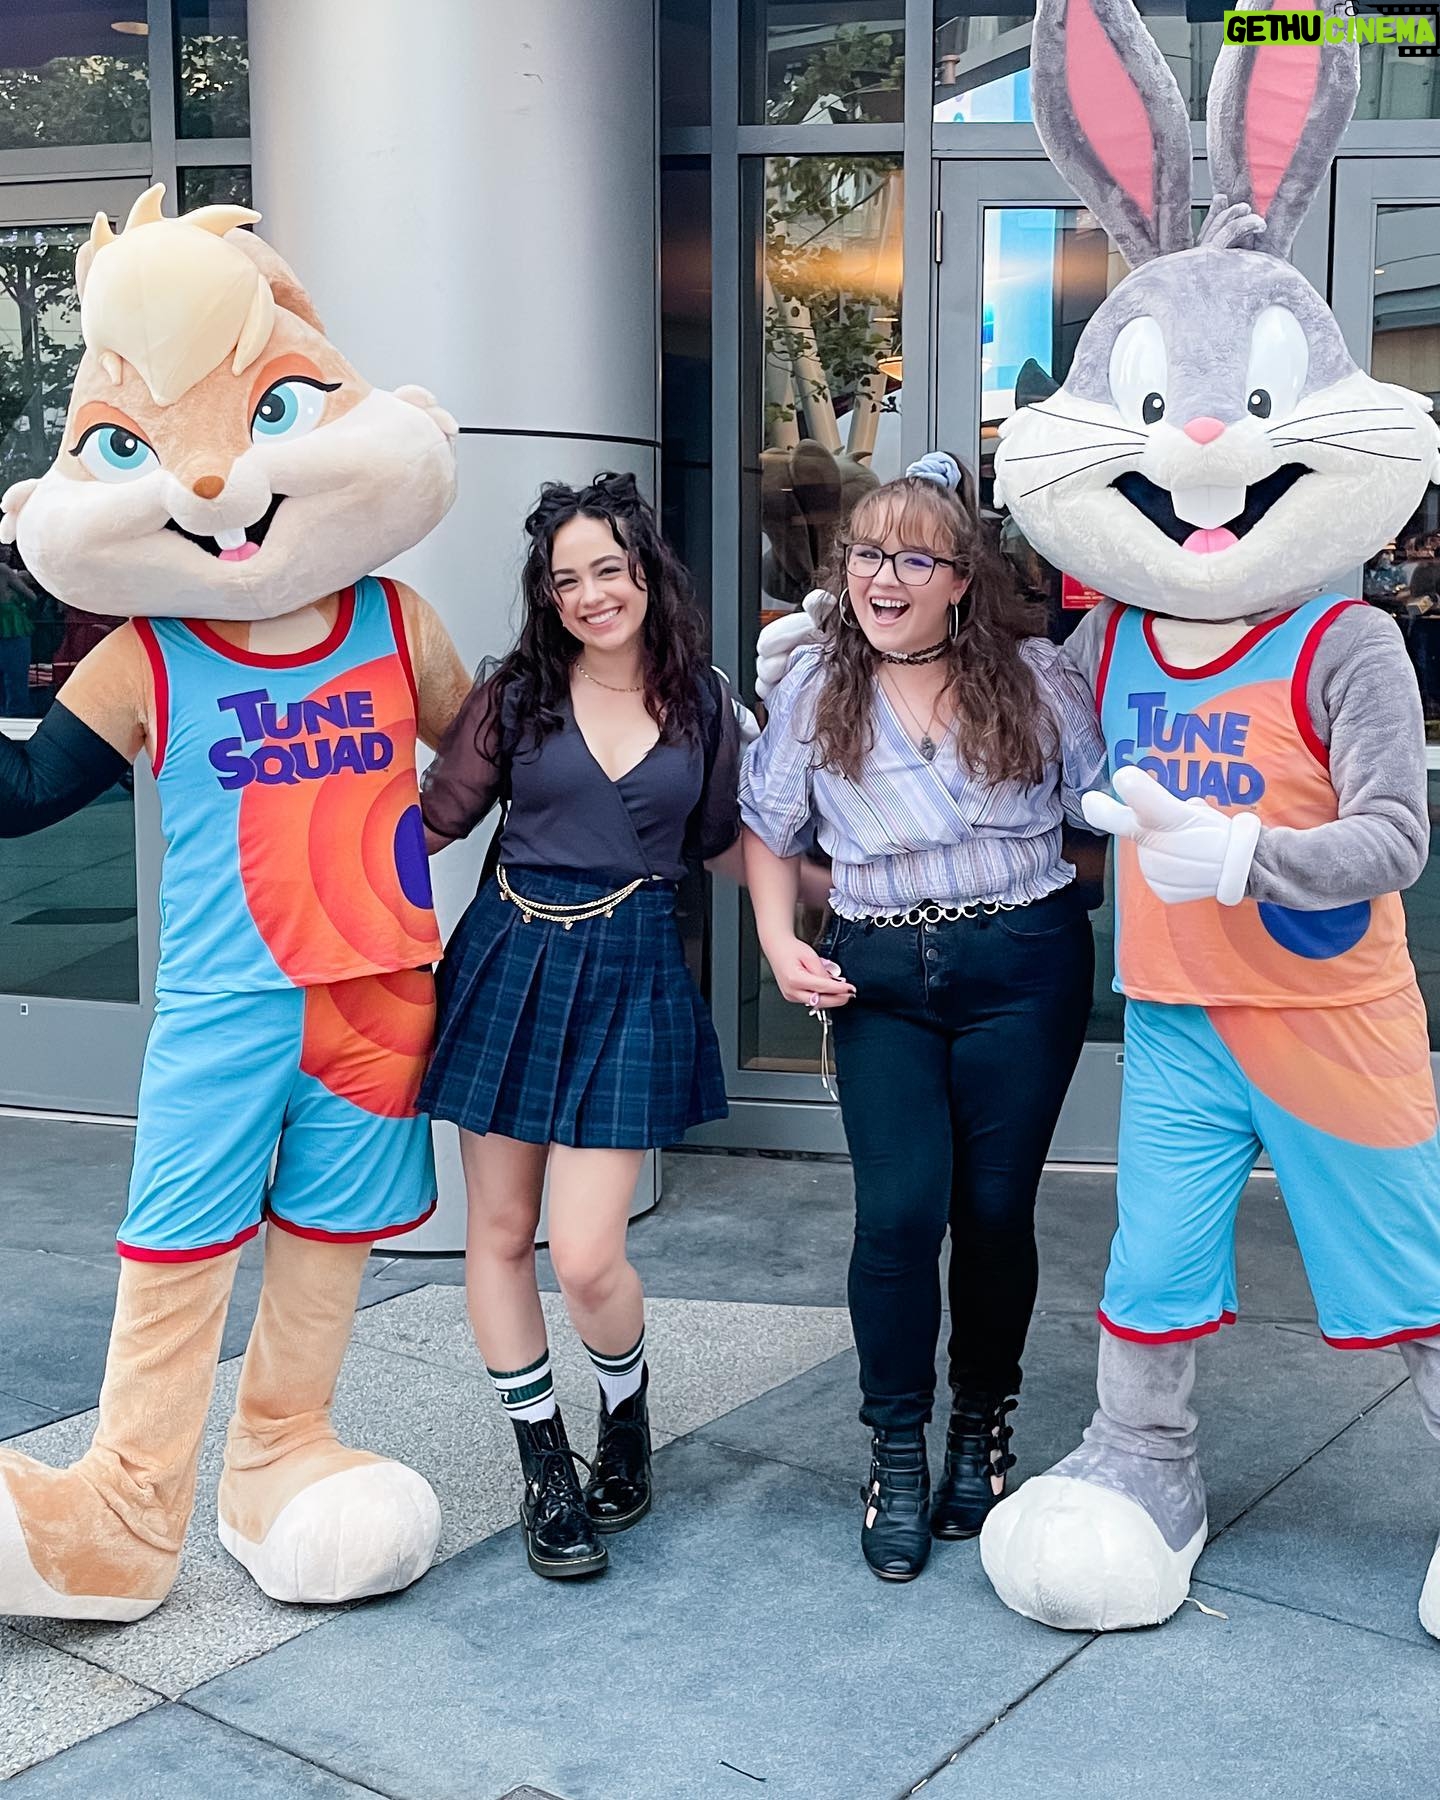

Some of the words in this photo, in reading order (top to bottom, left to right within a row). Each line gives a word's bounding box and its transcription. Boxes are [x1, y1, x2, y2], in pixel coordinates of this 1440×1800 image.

[217, 688, 375, 742] TUNE
[1128, 691, 1250, 757] TUNE
[208, 732, 394, 790] SQUAD
